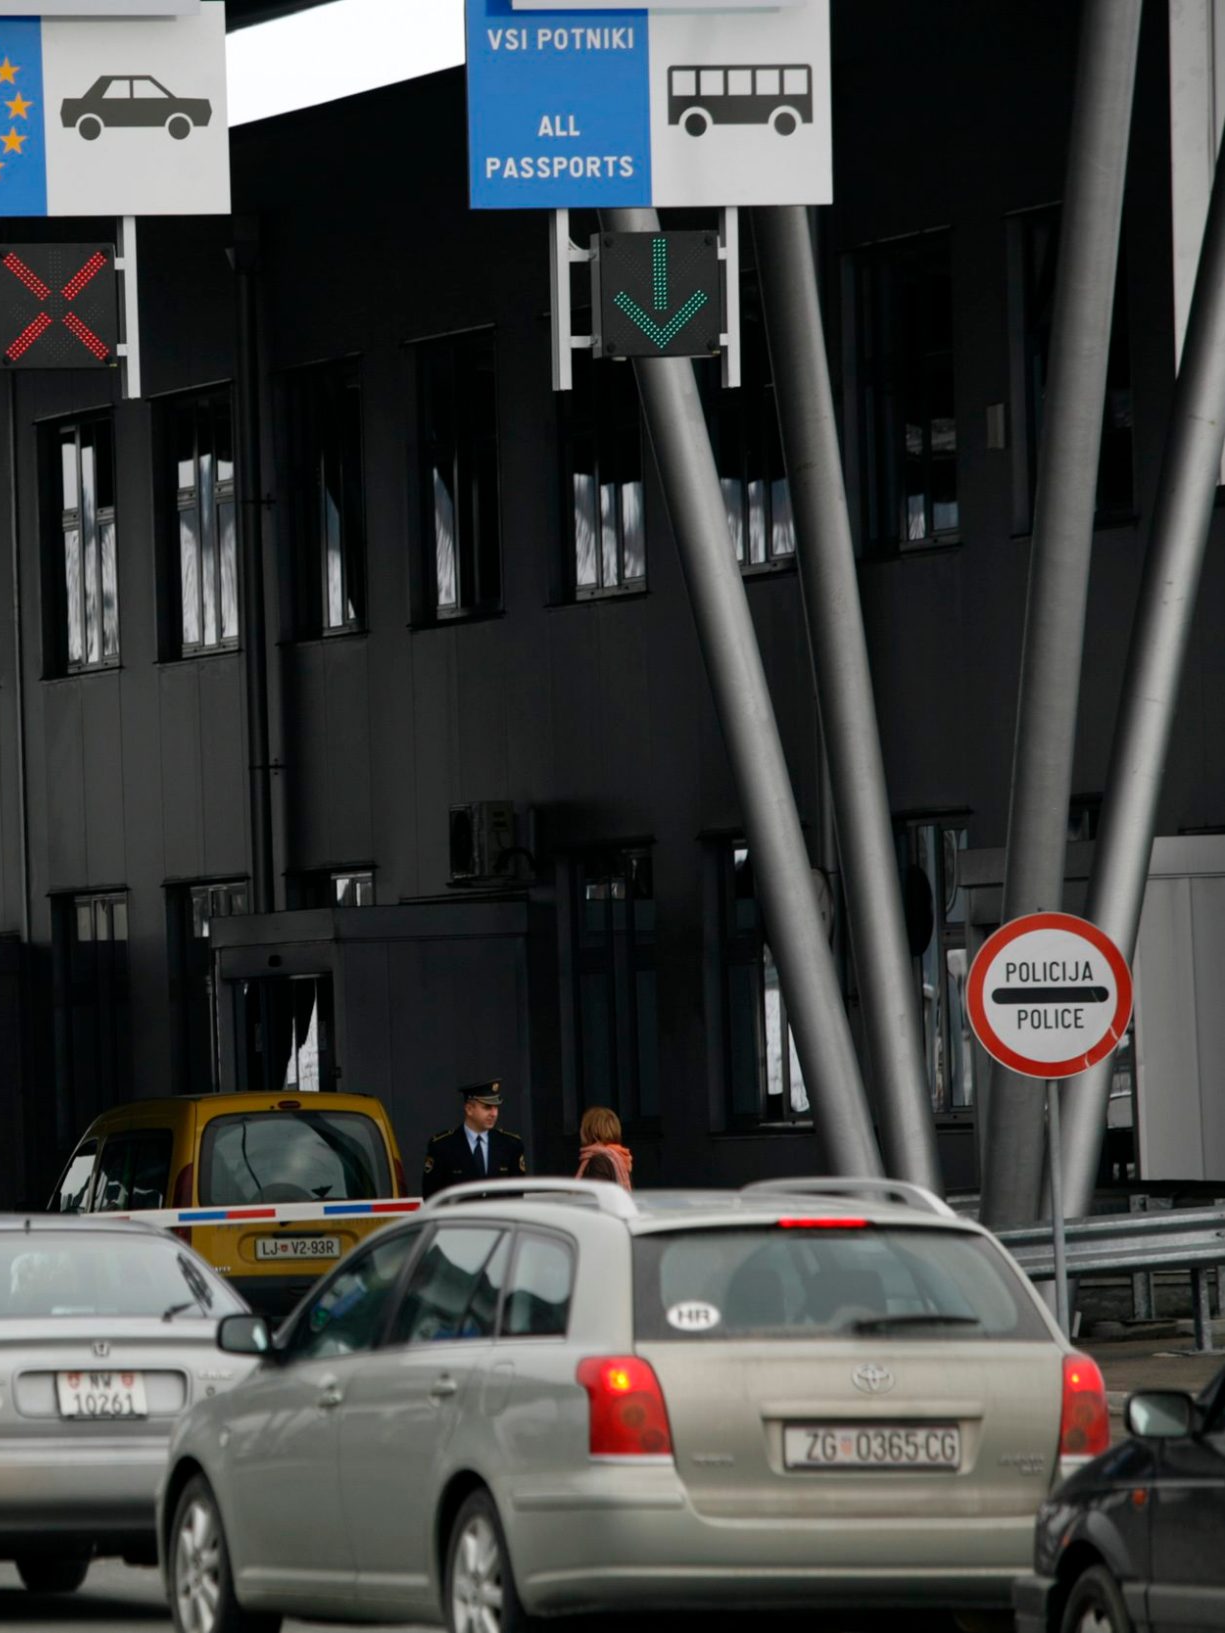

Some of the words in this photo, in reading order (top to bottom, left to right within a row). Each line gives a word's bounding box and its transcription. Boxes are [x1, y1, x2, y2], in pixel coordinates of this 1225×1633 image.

[487, 28, 527, 51] VSI
[537, 27, 634, 50] POTNIKI
[537, 114, 581, 137] ALL
[485, 155, 634, 179] PASSPORTS
[1005, 960, 1094, 983] POLICIJA
[1016, 1008, 1085, 1030] POLICE
[261, 1241, 278, 1256] LJ
[290, 1240, 336, 1256] V2-93R
[677, 1308, 712, 1325] HR
[89, 1373, 113, 1388] NW
[73, 1393, 134, 1416] 10261
[805, 1429, 838, 1462] ZG
[855, 1429, 958, 1462] 0365-CG
